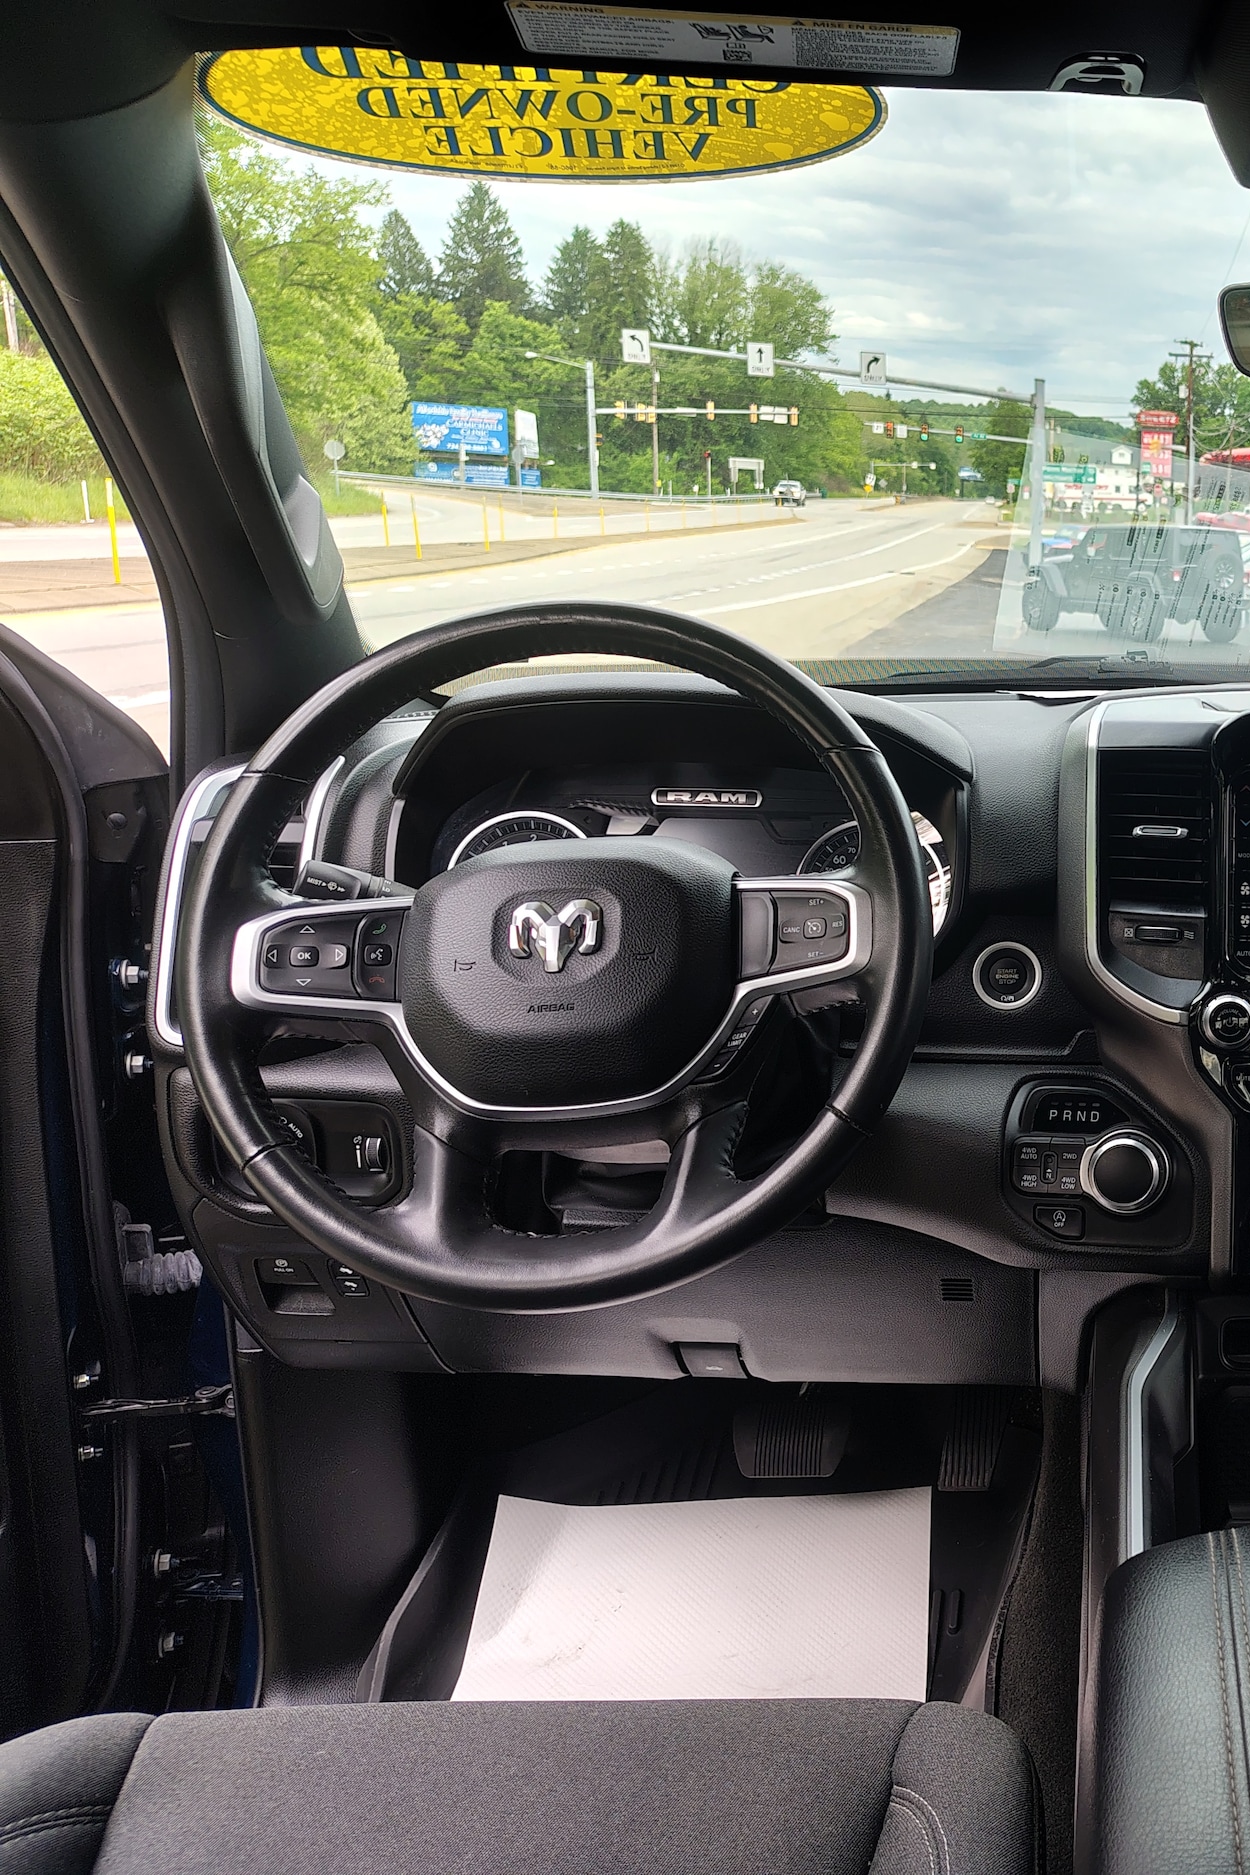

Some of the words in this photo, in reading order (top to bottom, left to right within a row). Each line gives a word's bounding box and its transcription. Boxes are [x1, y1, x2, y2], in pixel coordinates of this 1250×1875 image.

[535, 3, 605, 14] WARNING
[812, 21, 843, 29] MISE
[848, 22, 866, 31] EN
[868, 25, 913, 33] GARDE
[665, 791, 748, 804] RAM
[832, 855, 847, 865] 60
[306, 877, 322, 887] MIST
[831, 920, 843, 928] RES
[783, 926, 801, 934] CANC
[297, 951, 312, 960] OK
[527, 1002, 575, 1014] AIRBAG
[732, 1031, 748, 1041] GEAR
[727, 1039, 745, 1048] LIMIT
[1049, 1109, 1058, 1121] P
[1062, 1110, 1072, 1121] R
[1076, 1111, 1087, 1122] N
[1090, 1111, 1100, 1122] D
[288, 1122, 303, 1139] AUTO
[1062, 1152, 1077, 1160] 2WD
